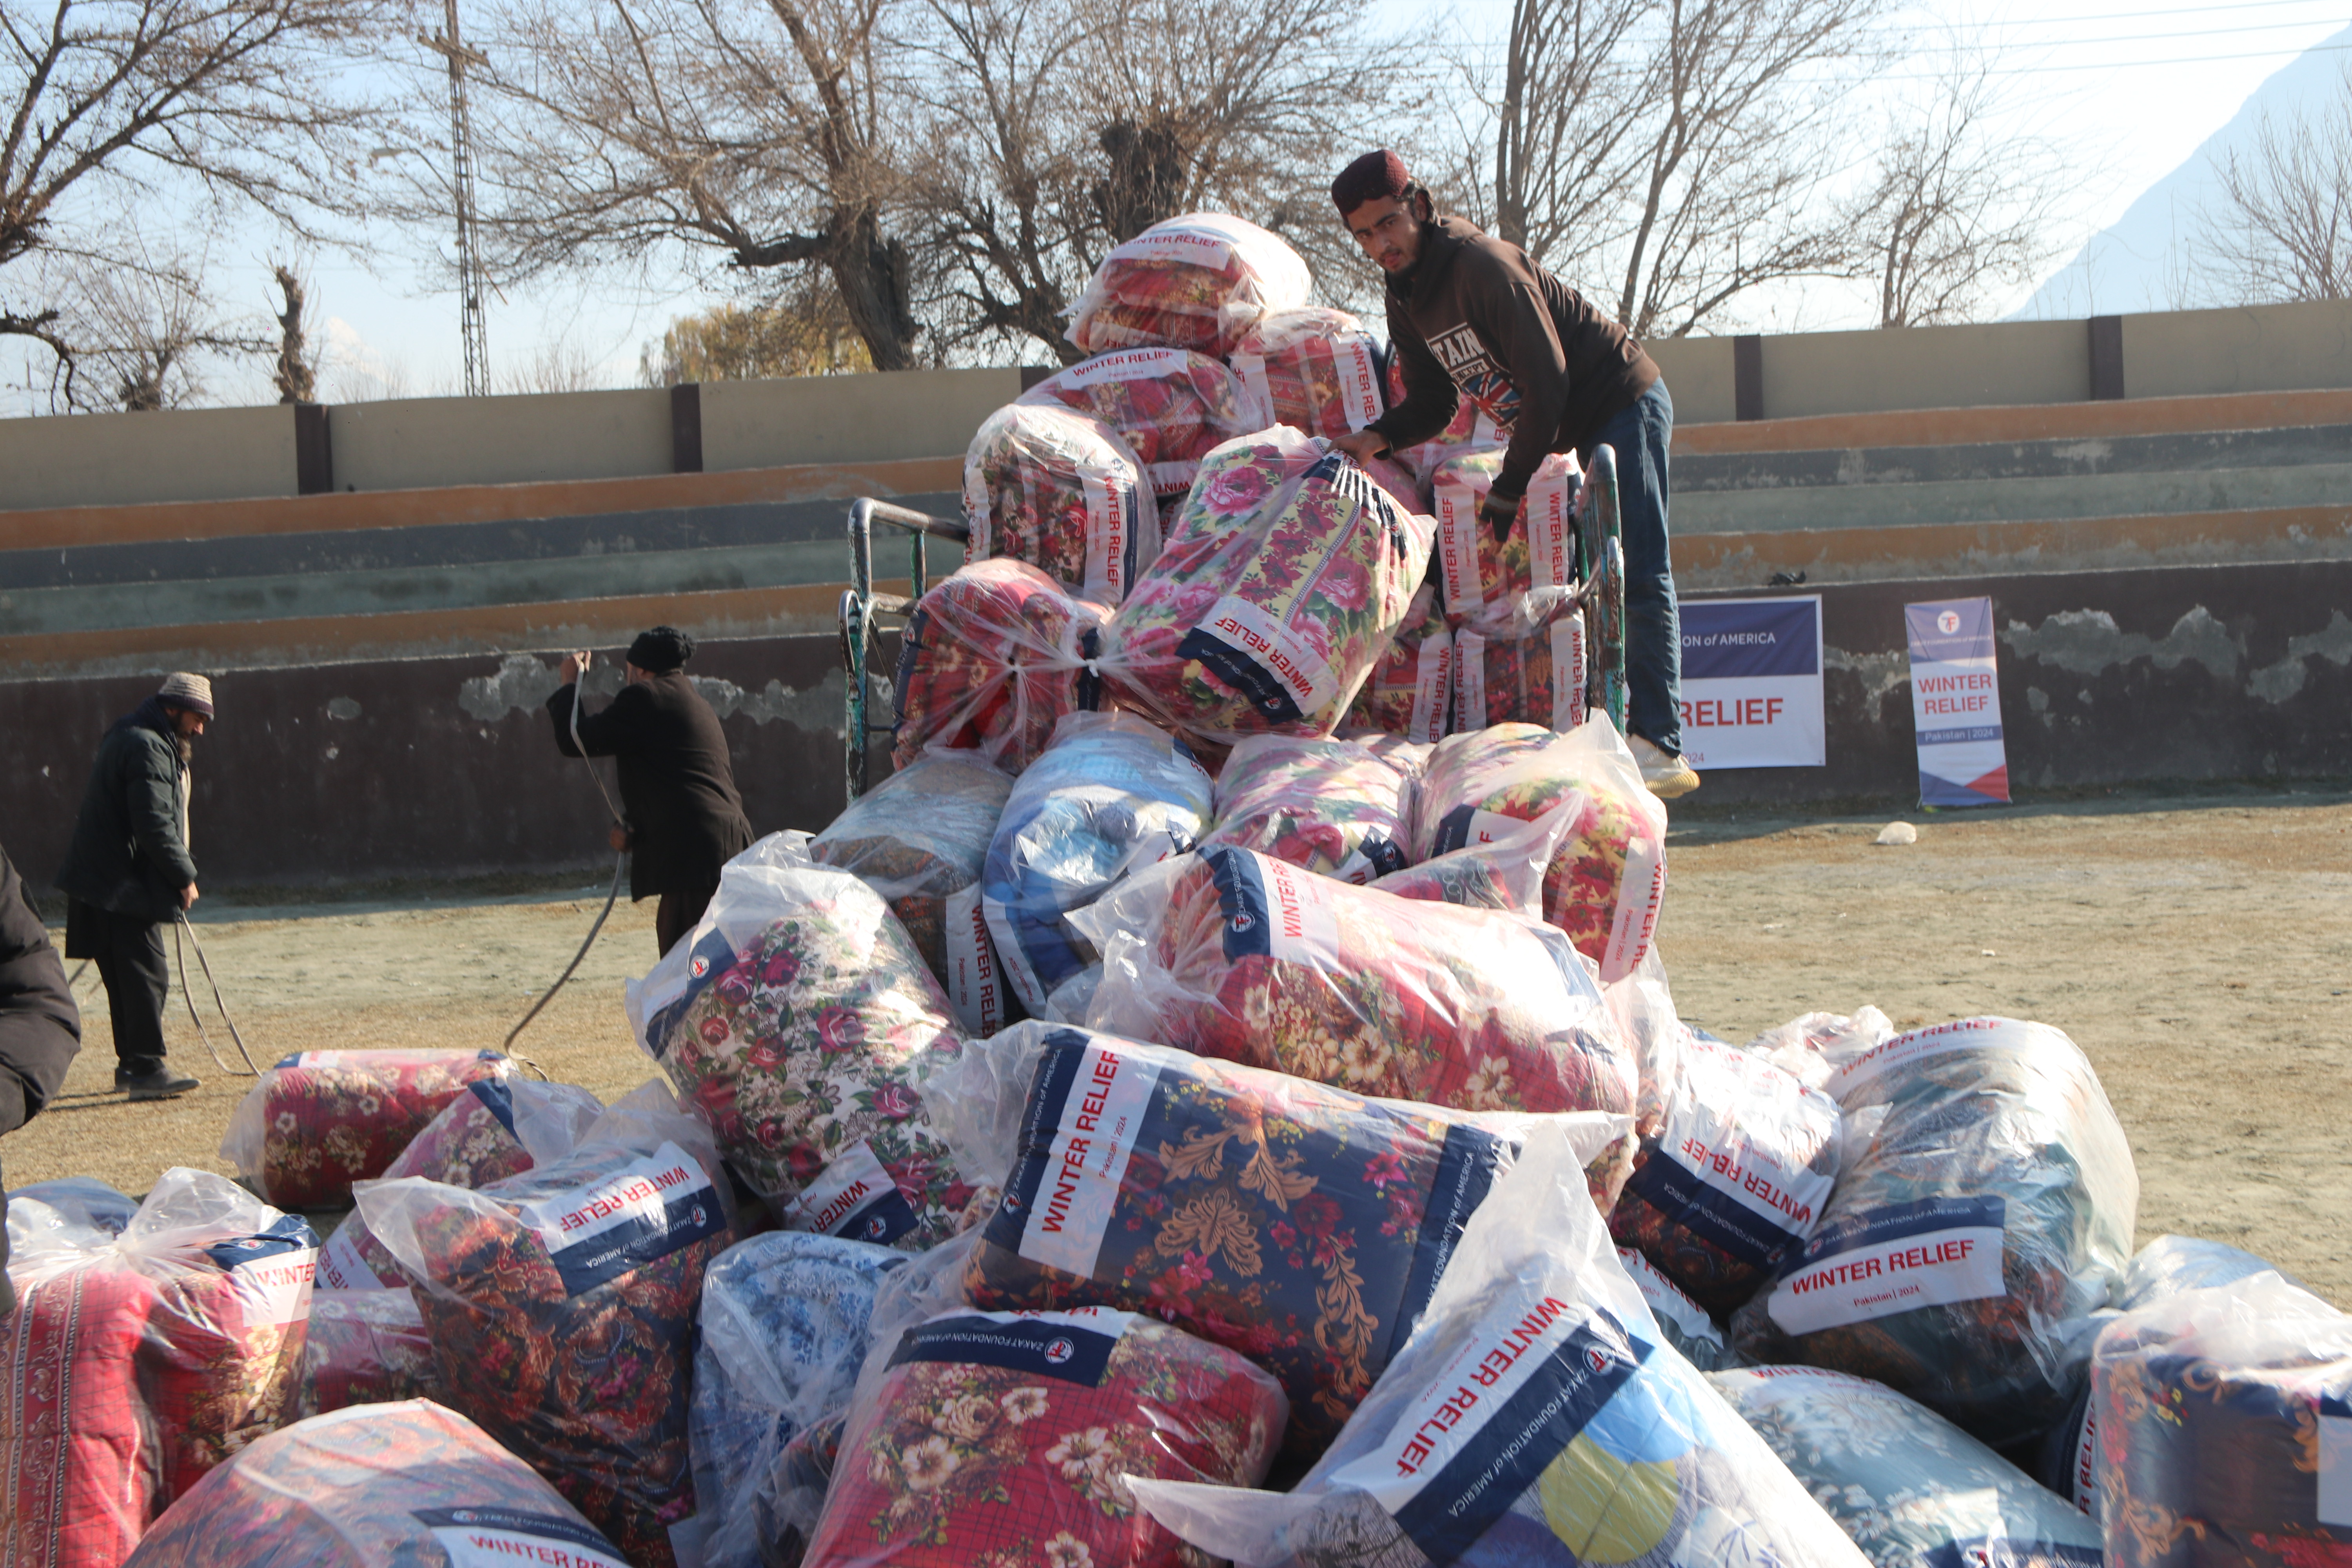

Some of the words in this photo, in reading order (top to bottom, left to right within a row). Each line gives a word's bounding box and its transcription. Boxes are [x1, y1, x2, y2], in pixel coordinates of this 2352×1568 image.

[1177, 234, 1221, 249] RELIEF
[1073, 353, 1125, 377] WINTER
[1128, 350, 1174, 364] RELIEF
[1350, 341, 1370, 392] WINTER
[1362, 394, 1378, 423] REL
[1104, 476, 1121, 532] WINTER
[1153, 481, 1191, 492] WINT
[1442, 497, 1454, 544] RELIEF
[1550, 491, 1561, 543] WINTER
[1107, 534, 1121, 588] RELIEF
[1446, 549, 1461, 601] WINTER
[1552, 546, 1563, 586] RELIE
[1214, 617, 1271, 653] RELIEF
[1265, 622, 1279, 634] 2024
[1281, 635, 1303, 655] Pakistan
[1704, 633, 1717, 646] of
[1720, 631, 1776, 646] AMERICA
[1269, 648, 1313, 698] WINTER
[1435, 647, 1450, 699] WINTER
[1455, 641, 1464, 688] RELIEF
[1572, 630, 1582, 684] WINTER
[1918, 673, 1992, 693] WINTER
[1429, 702, 1443, 744] RELIE
[1457, 691, 1466, 733] INTER
[1680, 697, 1784, 727] RELIEF
[1924, 695, 1988, 715] RELIEF
[1924, 730, 1965, 742] Pakistan
[1972, 727, 1993, 738] 2024
[1682, 752, 1705, 764] 024
[1441, 825, 1454, 855] MERICA
[1276, 878, 1303, 938] WINTER
[1640, 862, 1662, 938] WINTER
[971, 905, 991, 980] WINTER
[1621, 909, 1633, 940] Pakistan
[1019, 975, 1034, 1003] Pakistan
[1841, 1033, 1915, 1076] WINTER
[1922, 1020, 2004, 1040] RELIEF
[1883, 1047, 1916, 1065] Pakistan
[1922, 1041, 1941, 1052] 2024
[1044, 1048, 1062, 1089] AMERICA
[1040, 1087, 1049, 1101] of
[1042, 1132, 1091, 1233] WINTER
[1076, 1051, 1121, 1132] RELIEF
[1099, 1140, 1117, 1178] Pakistan
[1113, 1116, 1128, 1138] 2024
[1681, 1138, 1743, 1183] RELIEF
[622, 1165, 690, 1202] WINTER
[1013, 1149, 1032, 1190] ZAKAT
[1456, 1152, 1475, 1197] AMERICA
[560, 1196, 624, 1232] RELIEF
[814, 1180, 870, 1232] WINTER
[1454, 1195, 1462, 1209] of
[1744, 1170, 1812, 1225] WINTER
[1914, 1212, 1926, 1221] of
[1925, 1206, 1971, 1218] AMERICA
[630, 1222, 673, 1249] FOUNDATION
[672, 1216, 692, 1231] ZAKAT
[586, 1246, 624, 1269] AMERICA
[622, 1241, 630, 1255] of
[1434, 1208, 1459, 1277] FOUNDATION
[257, 1263, 315, 1287] WINTE
[1792, 1257, 1882, 1296] WINTER
[1889, 1239, 1975, 1272] RELIEF
[1853, 1291, 1893, 1307] Pakistan
[1898, 1285, 1920, 1296] 2024
[951, 1332, 1011, 1346] FOUNDATION
[1010, 1338, 1044, 1351] ZAKAT
[1471, 1297, 1569, 1387] WINTER
[1560, 1371, 1590, 1402] ZAKAT
[1396, 1386, 1479, 1479] RELIEF
[1504, 1398, 1563, 1459] FOUNDATION
[1491, 1457, 1504, 1477] of
[1448, 1473, 1492, 1519] AMERICA
[469, 1534, 570, 1568] WINTER
